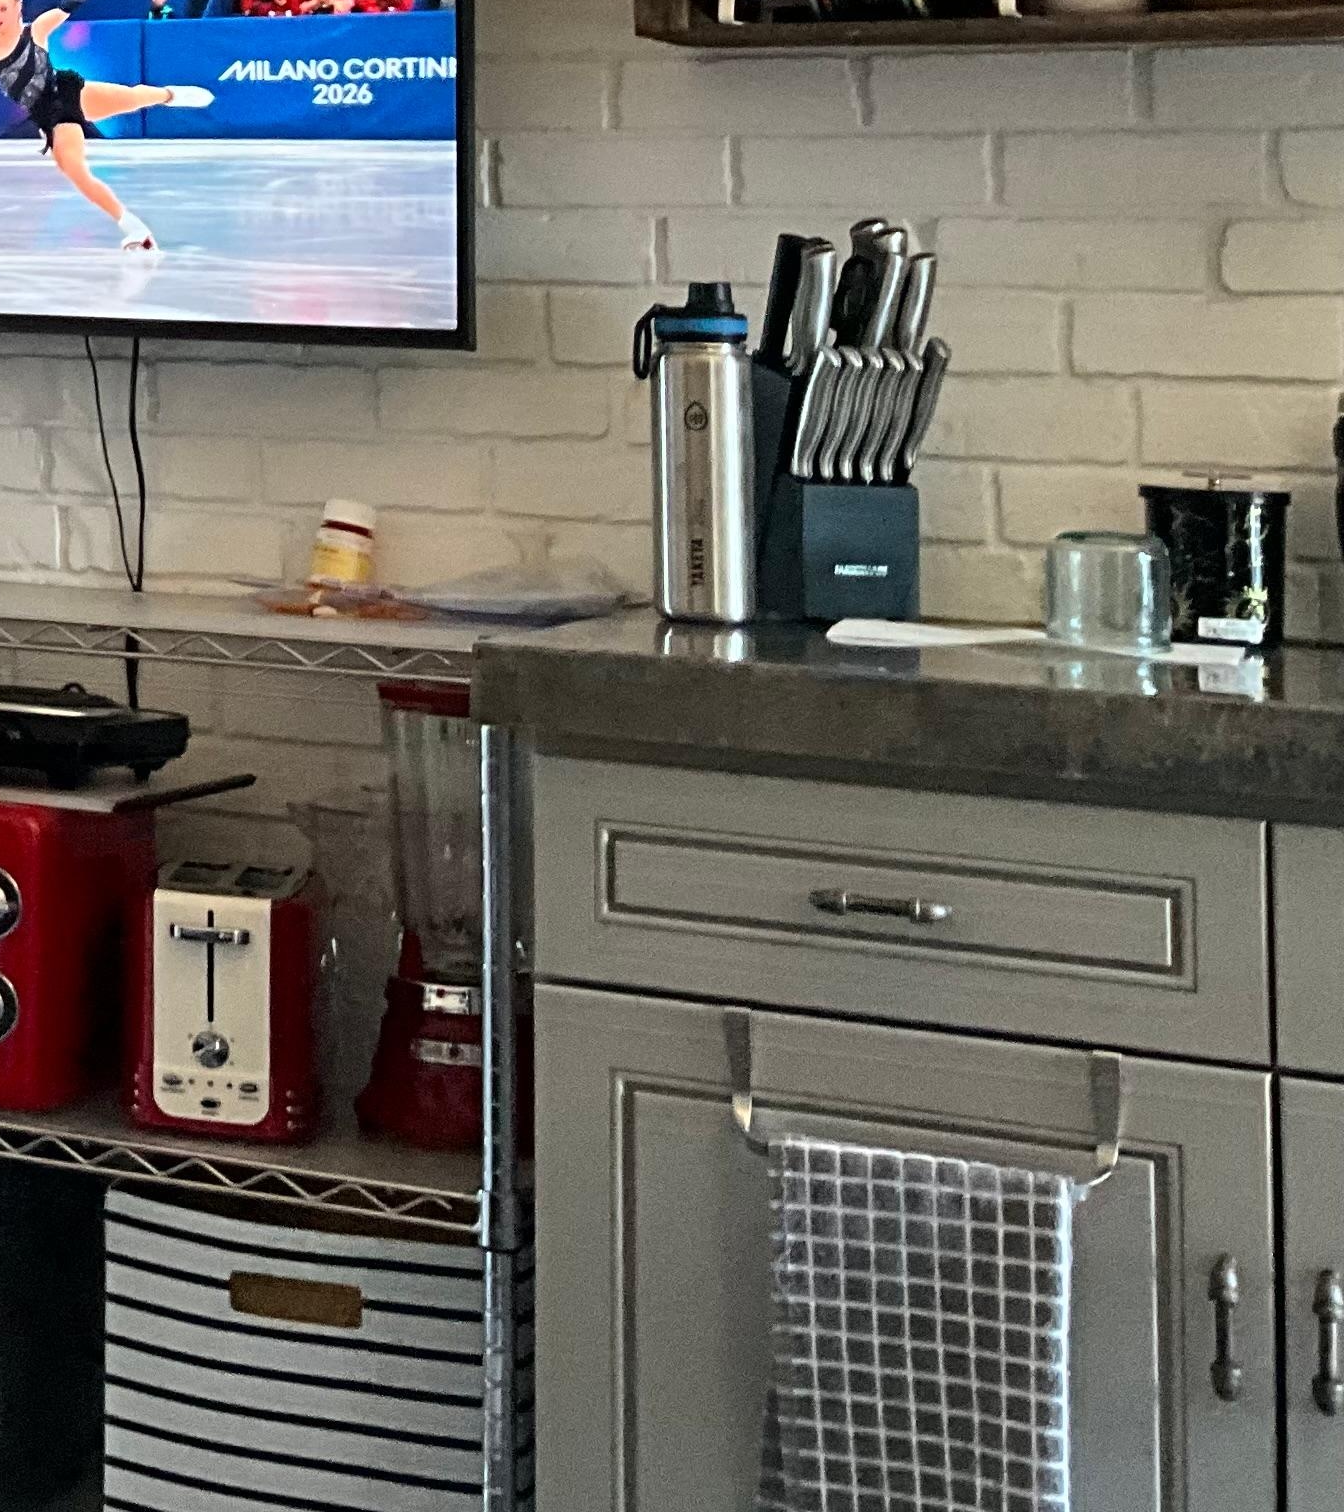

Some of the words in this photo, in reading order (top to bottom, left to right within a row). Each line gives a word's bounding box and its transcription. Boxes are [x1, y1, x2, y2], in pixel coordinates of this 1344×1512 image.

[218, 58, 339, 81] MILANO
[343, 56, 457, 80] CORTIN
[312, 83, 373, 105] 2026
